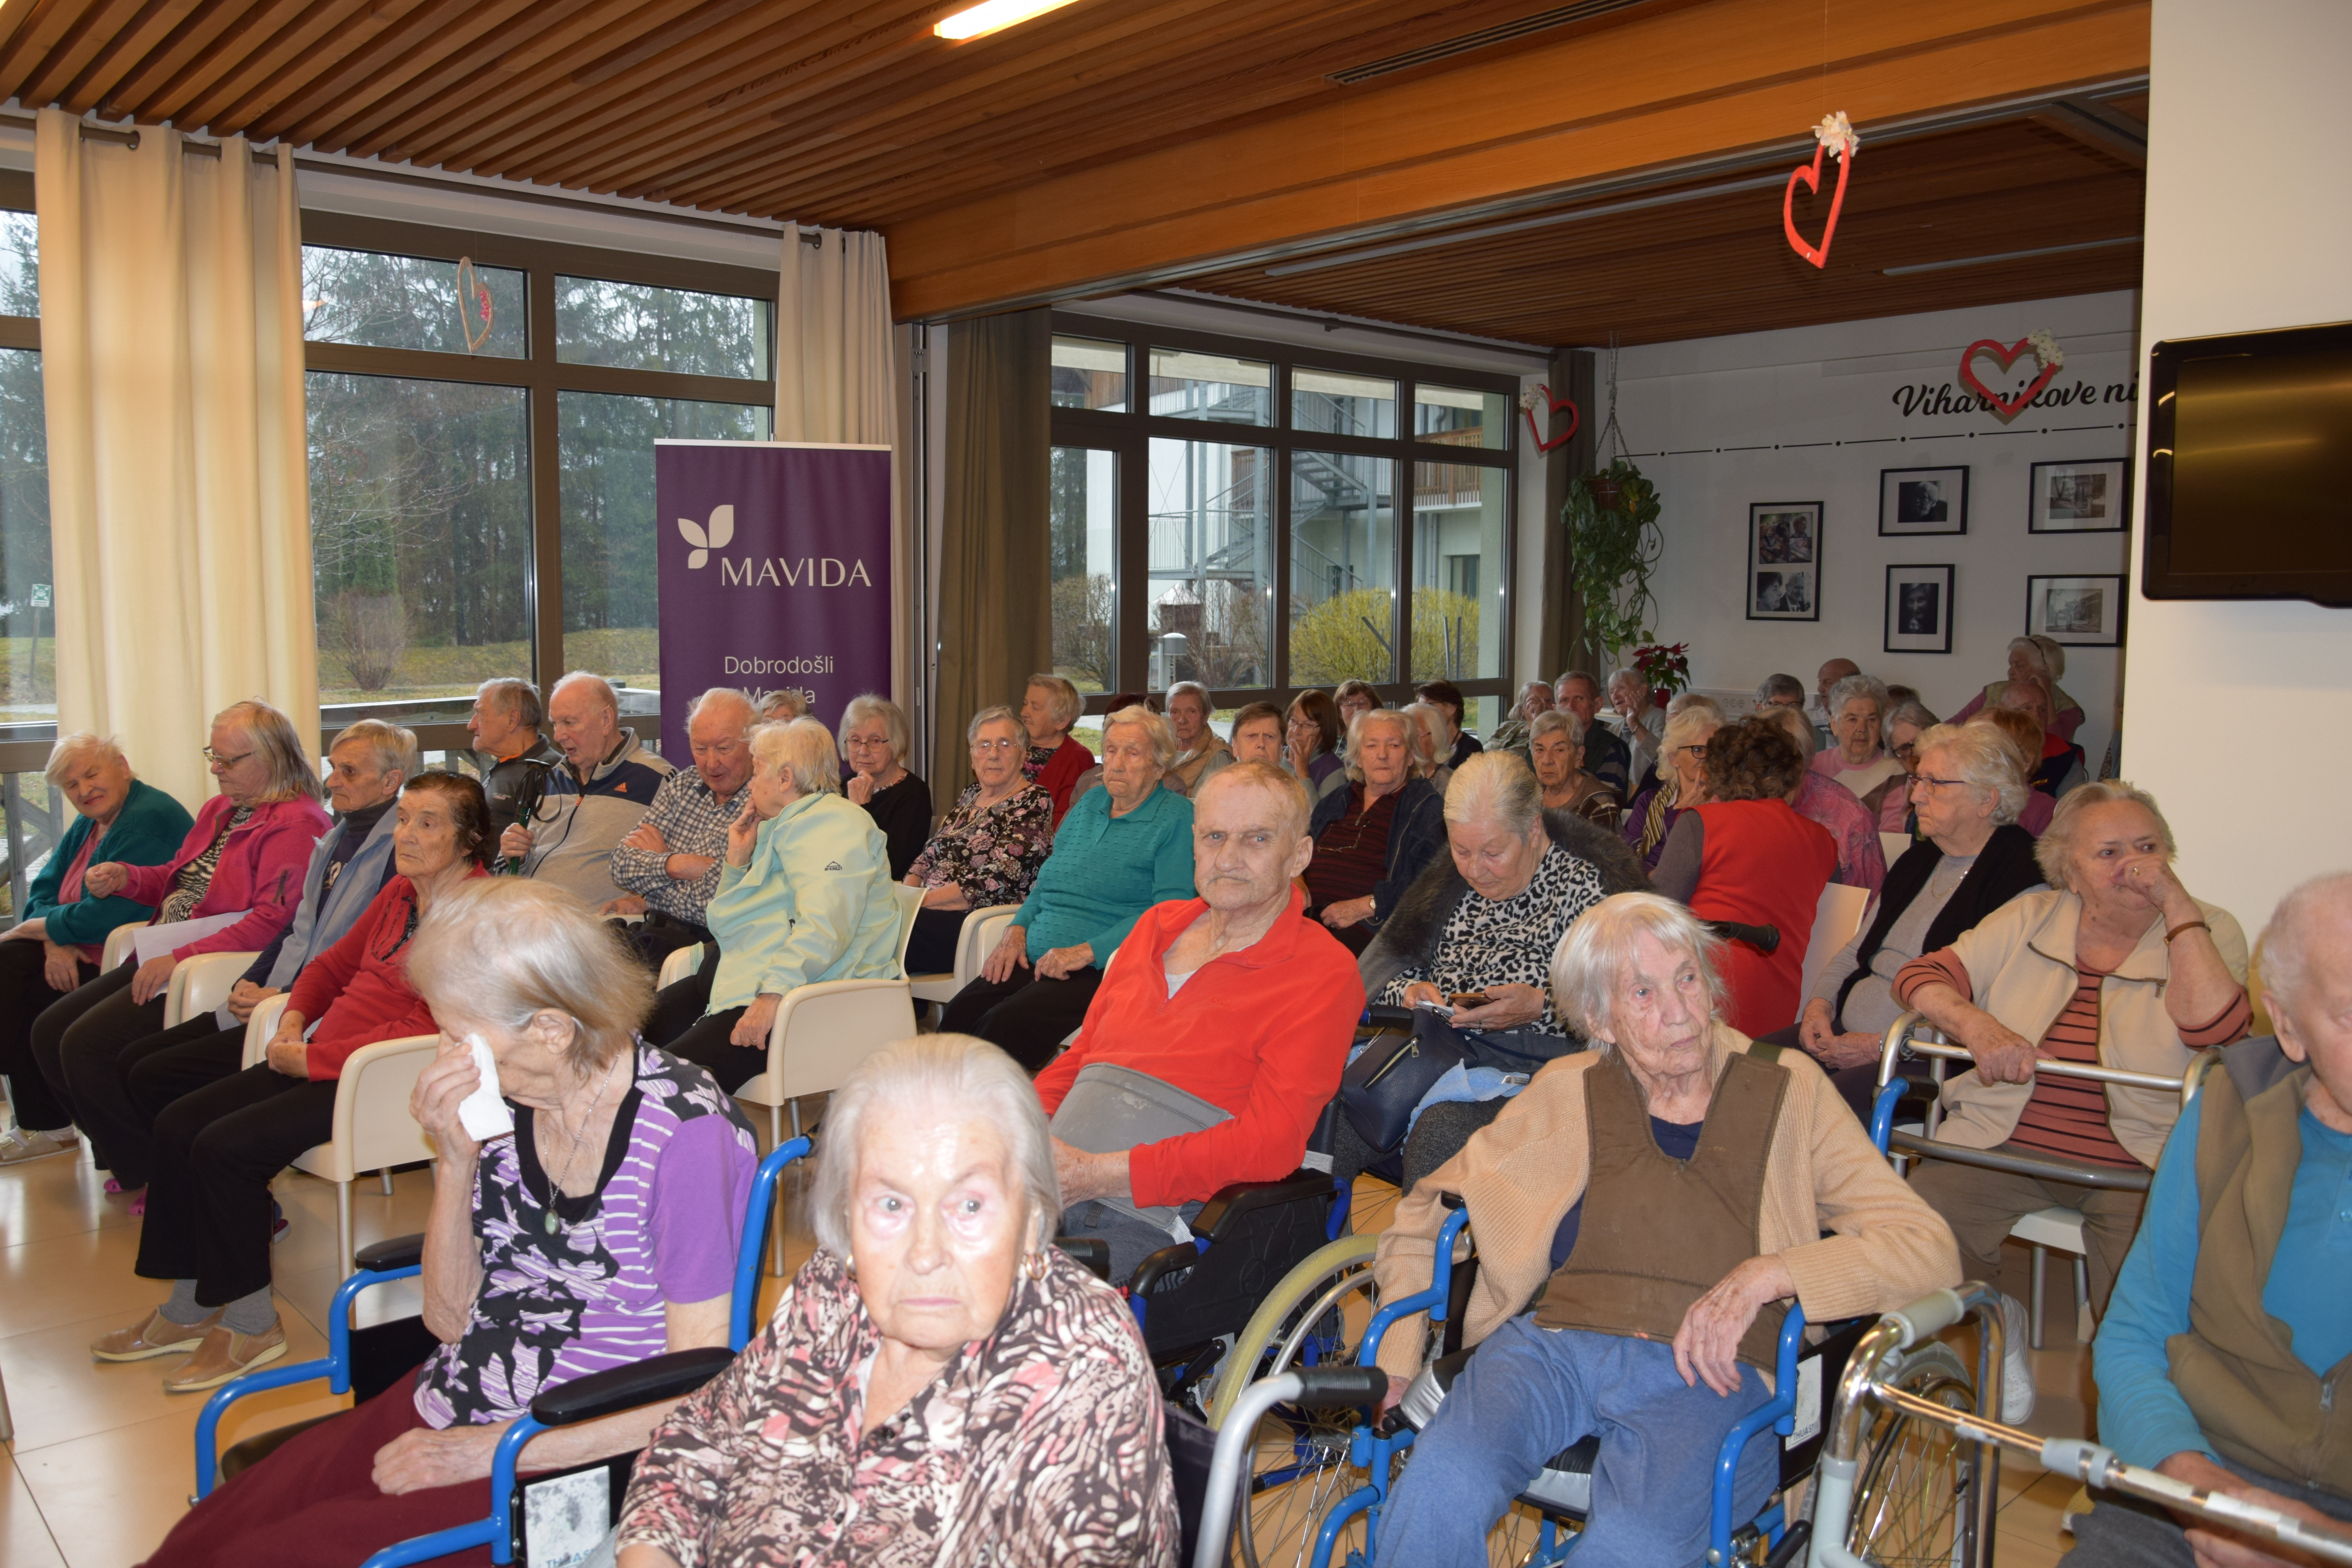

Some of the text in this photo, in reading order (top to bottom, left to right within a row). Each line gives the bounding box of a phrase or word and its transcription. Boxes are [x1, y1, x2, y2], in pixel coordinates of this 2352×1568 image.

[722, 557, 871, 587] MAVIDA
[725, 655, 833, 674] Dobrodošli
[1793, 1423, 1814, 1441] THUAS
